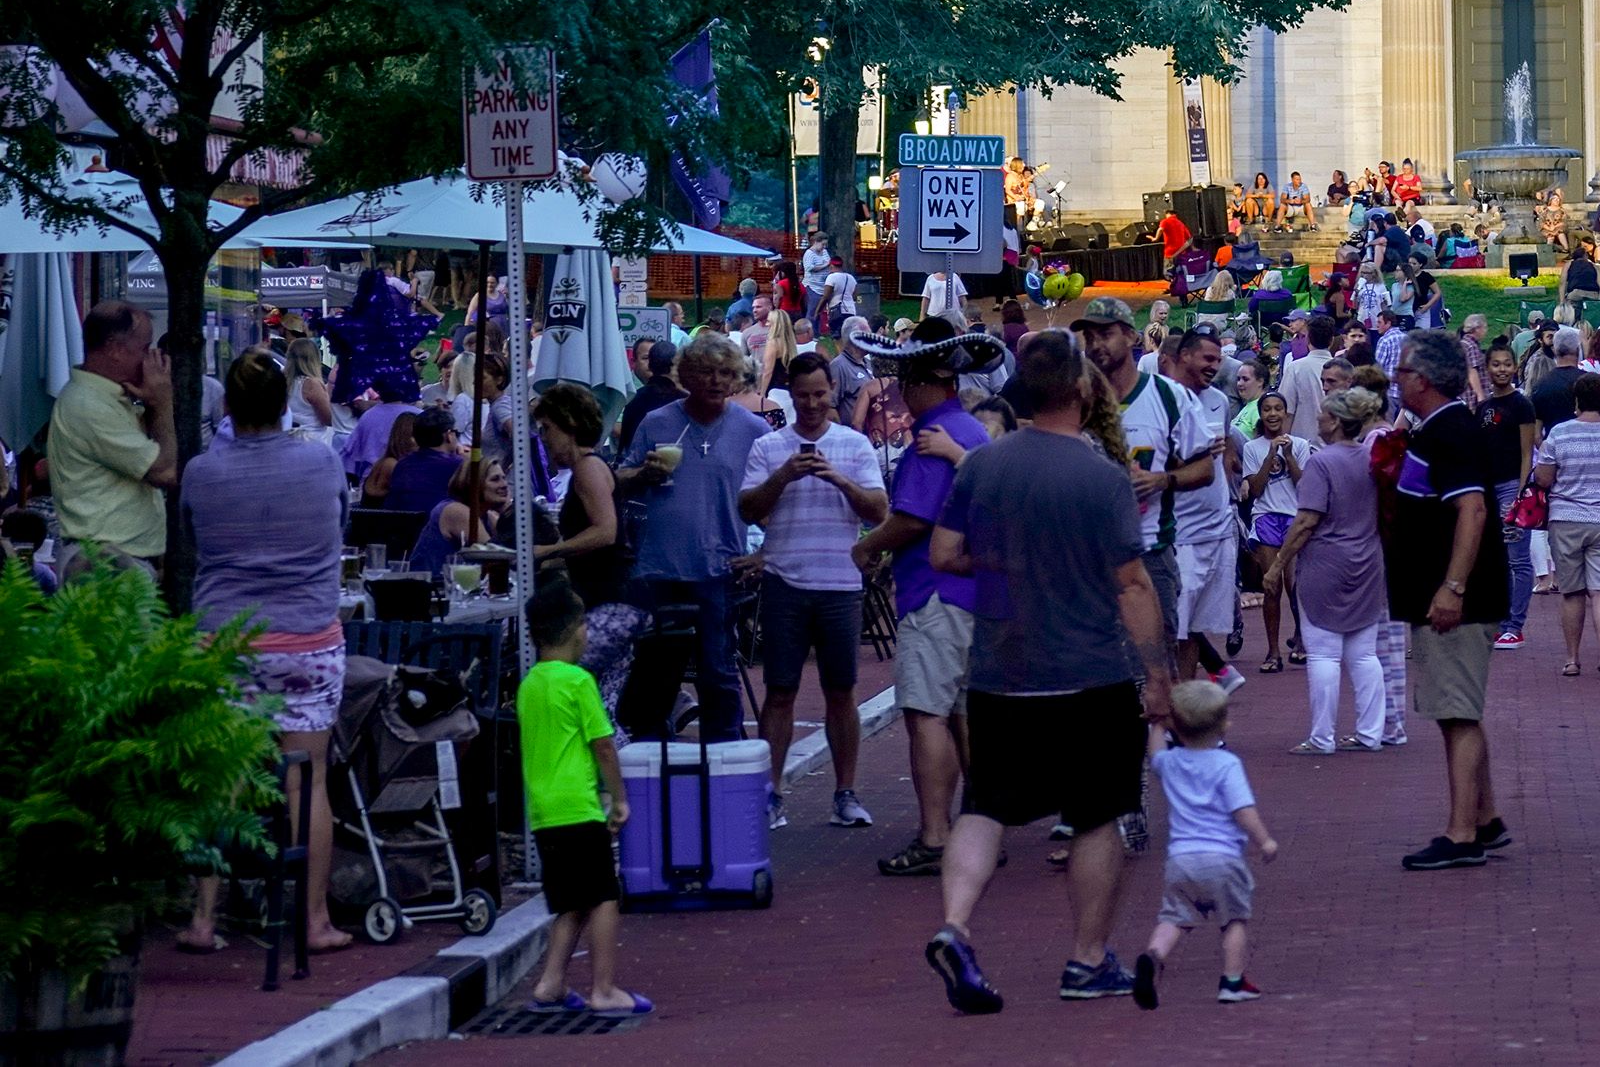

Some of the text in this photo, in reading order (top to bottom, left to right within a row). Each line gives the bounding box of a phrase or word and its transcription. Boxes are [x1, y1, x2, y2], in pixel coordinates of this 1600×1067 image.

[467, 88, 548, 114] PARKNG
[492, 118, 530, 140] ANY
[490, 145, 535, 166] TIME
[904, 138, 999, 163] BROADWAY
[928, 176, 974, 196] ONE
[927, 198, 976, 218] WAY
